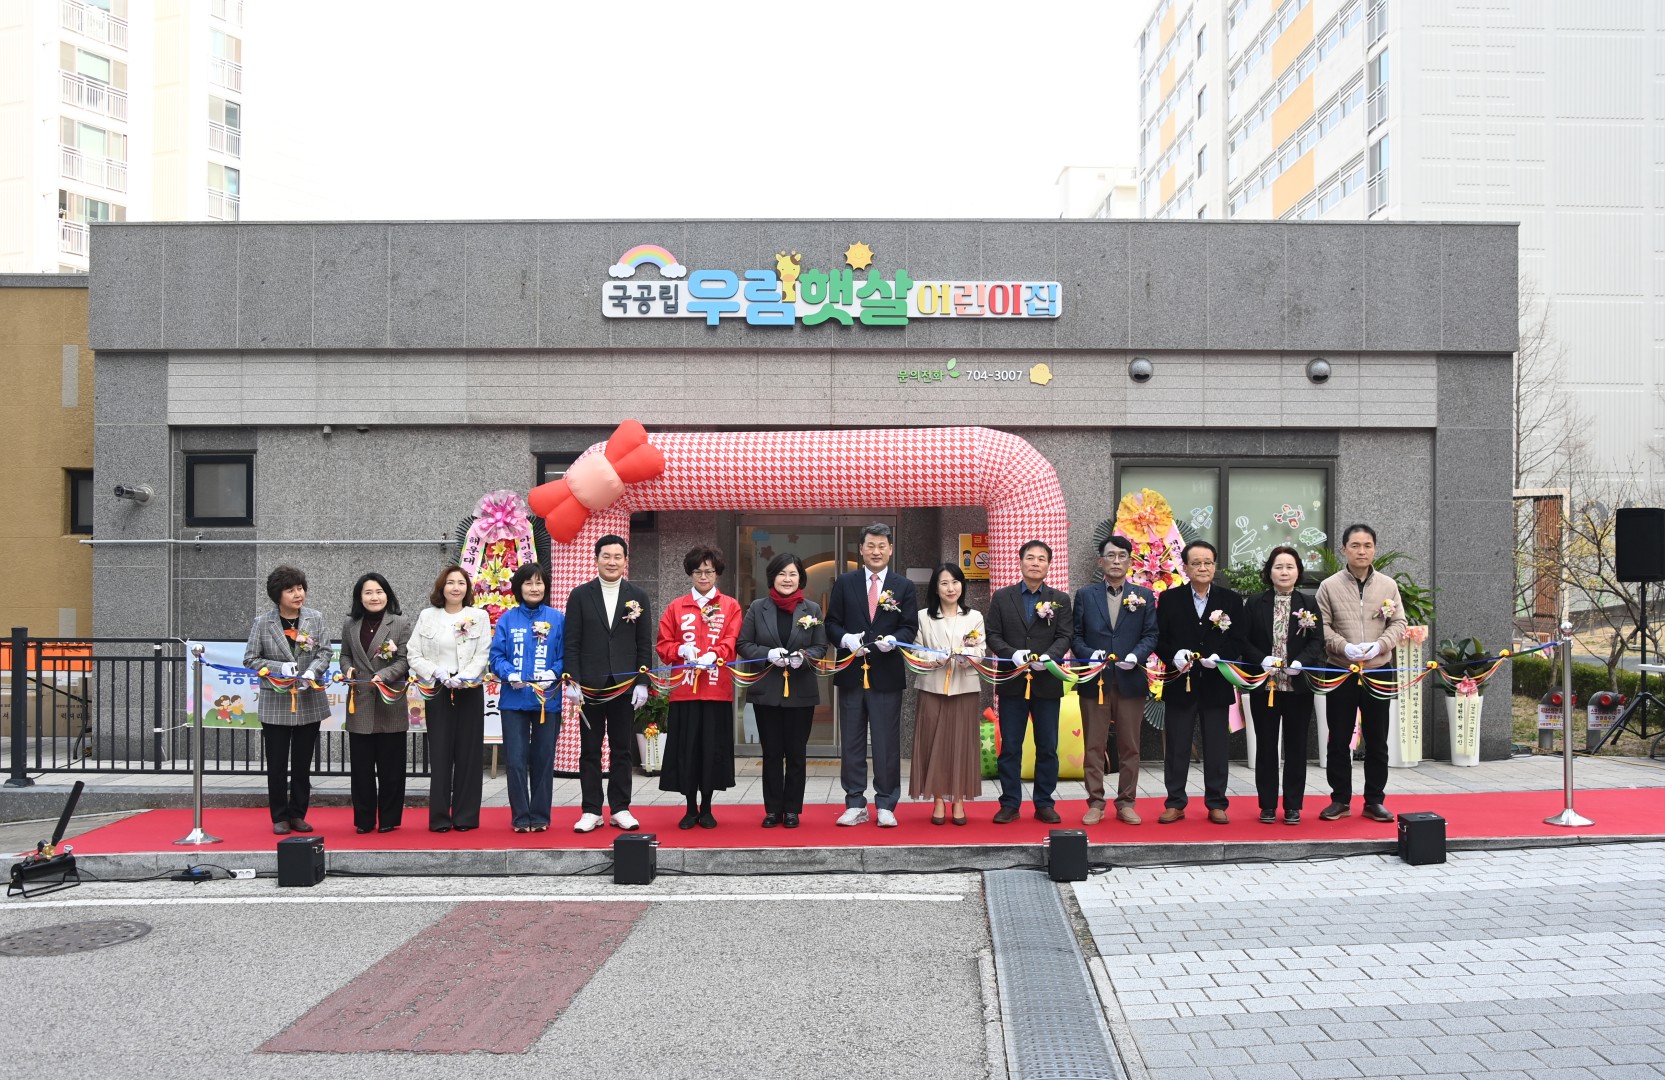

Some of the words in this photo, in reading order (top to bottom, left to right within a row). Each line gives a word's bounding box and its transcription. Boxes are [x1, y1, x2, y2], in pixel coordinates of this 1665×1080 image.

[608, 284, 680, 315] 국공립
[898, 369, 945, 383] 문의전화
[966, 370, 1023, 381] 704-3007
[463, 536, 481, 566] 해운대
[513, 643, 524, 681] 시의
[533, 645, 547, 681] 최은
[706, 628, 721, 681] 구원
